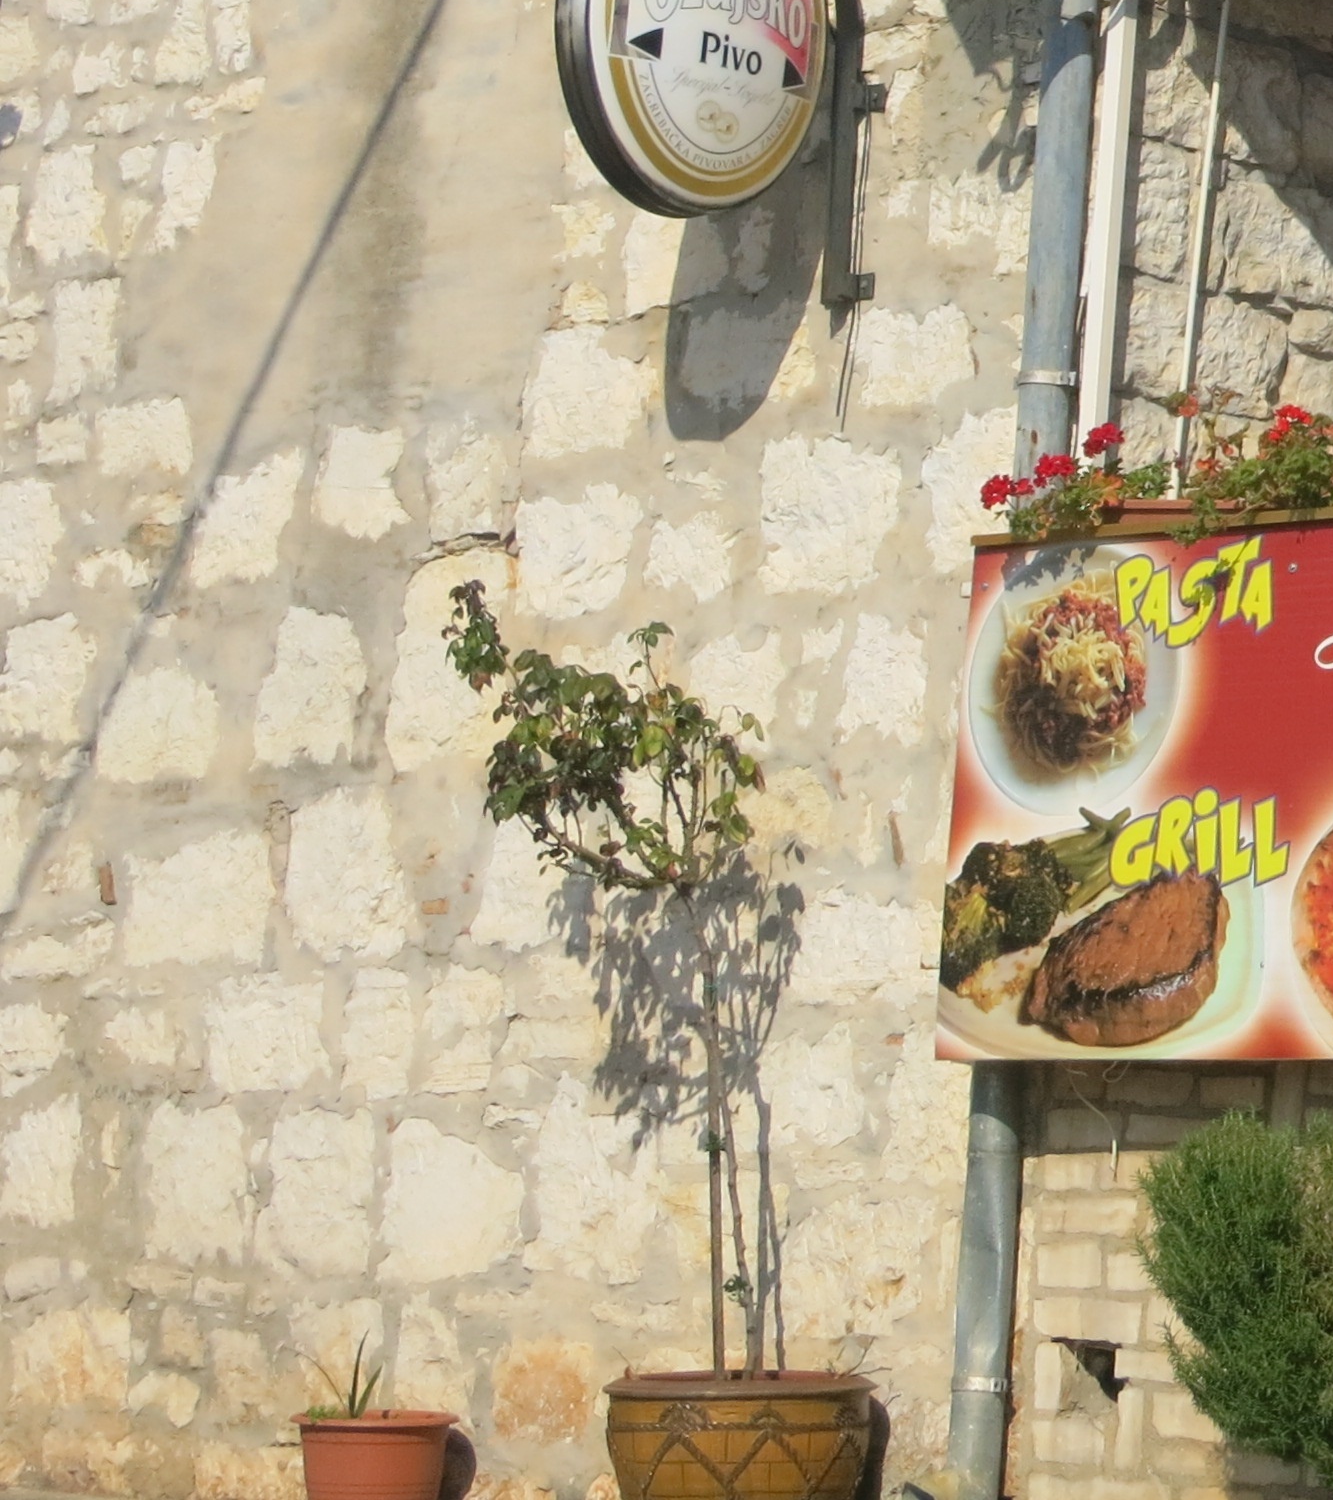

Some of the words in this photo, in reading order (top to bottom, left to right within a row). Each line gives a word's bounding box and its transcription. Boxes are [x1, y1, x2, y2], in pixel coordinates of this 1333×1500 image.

[700, 30, 762, 75] Pivo
[639, 73, 691, 158] ZAGREBAČKA
[692, 154, 753, 170] PIVOVARA
[1113, 534, 1276, 648] PASTA
